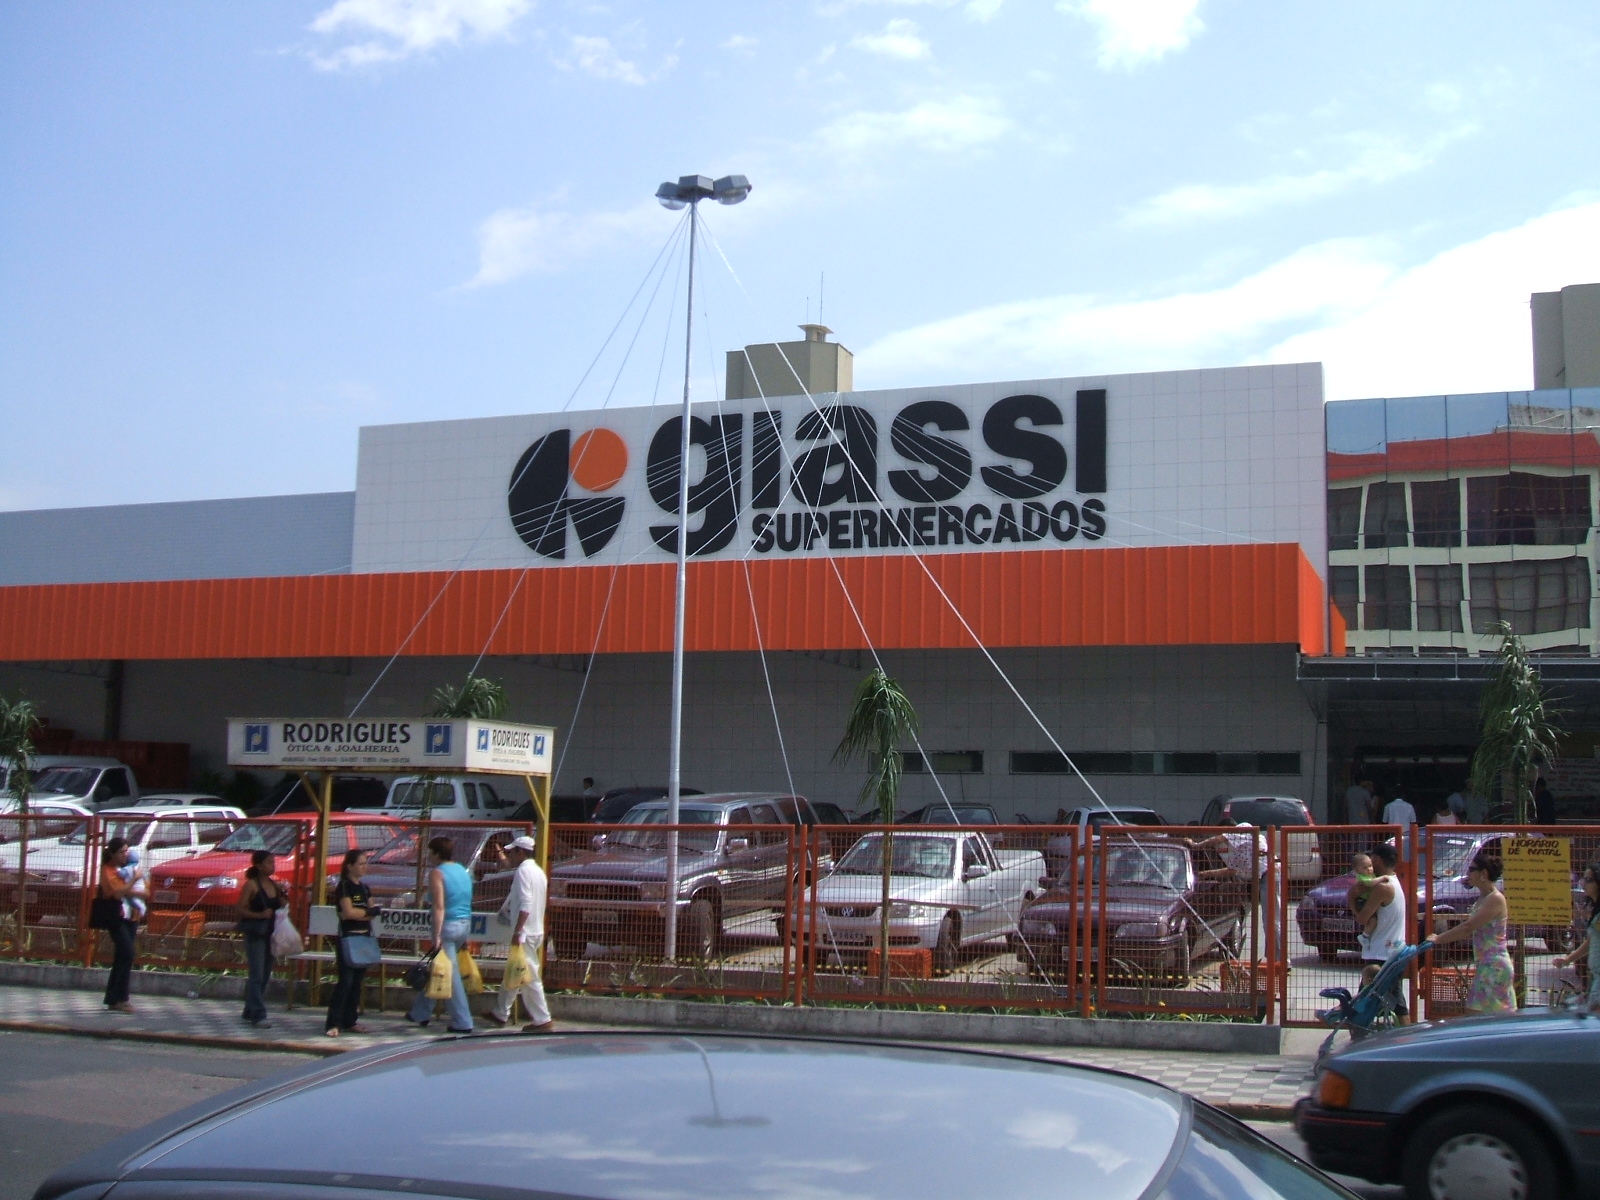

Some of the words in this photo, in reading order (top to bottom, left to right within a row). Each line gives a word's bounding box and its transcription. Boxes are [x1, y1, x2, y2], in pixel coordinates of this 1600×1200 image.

[751, 498, 1107, 553] SUPERMERCADOS
[282, 722, 411, 744] RODRIGUES
[492, 729, 530, 749] RODRIGUES
[287, 743, 320, 753] ÓTICA
[334, 745, 400, 753] JOALHERIA
[1508, 847, 1520, 855] DE
[1527, 848, 1562, 857] NATAL
[381, 910, 432, 925] RODRI
